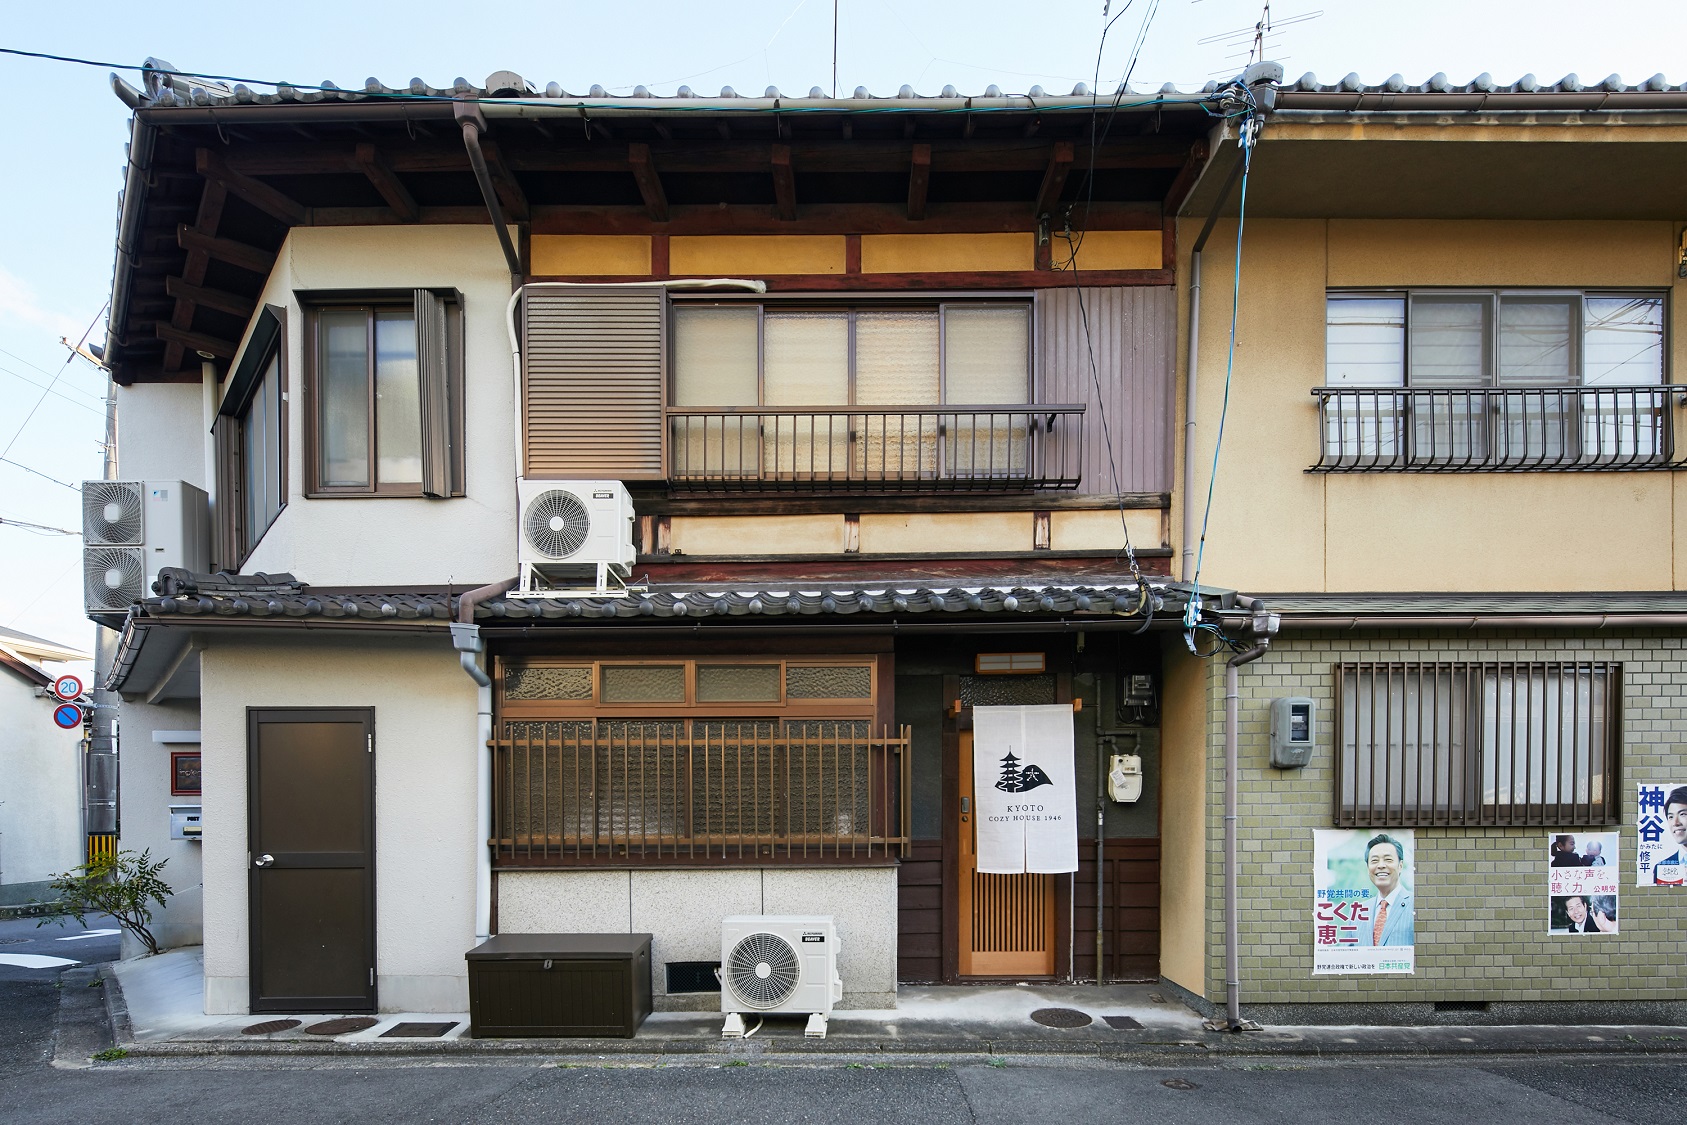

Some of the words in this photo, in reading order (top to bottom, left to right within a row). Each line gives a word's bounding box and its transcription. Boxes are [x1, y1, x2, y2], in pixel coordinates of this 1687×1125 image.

[61, 682, 77, 693] 20
[1639, 786, 1664, 842] 神谷
[1640, 851, 1651, 873] 修平
[1551, 869, 1609, 880] 小さな声を、
[1551, 882, 1587, 894] 聴く力。
[1593, 885, 1617, 893] 公明党
[1317, 902, 1369, 921] こくた
[1318, 925, 1358, 944] 恵二
